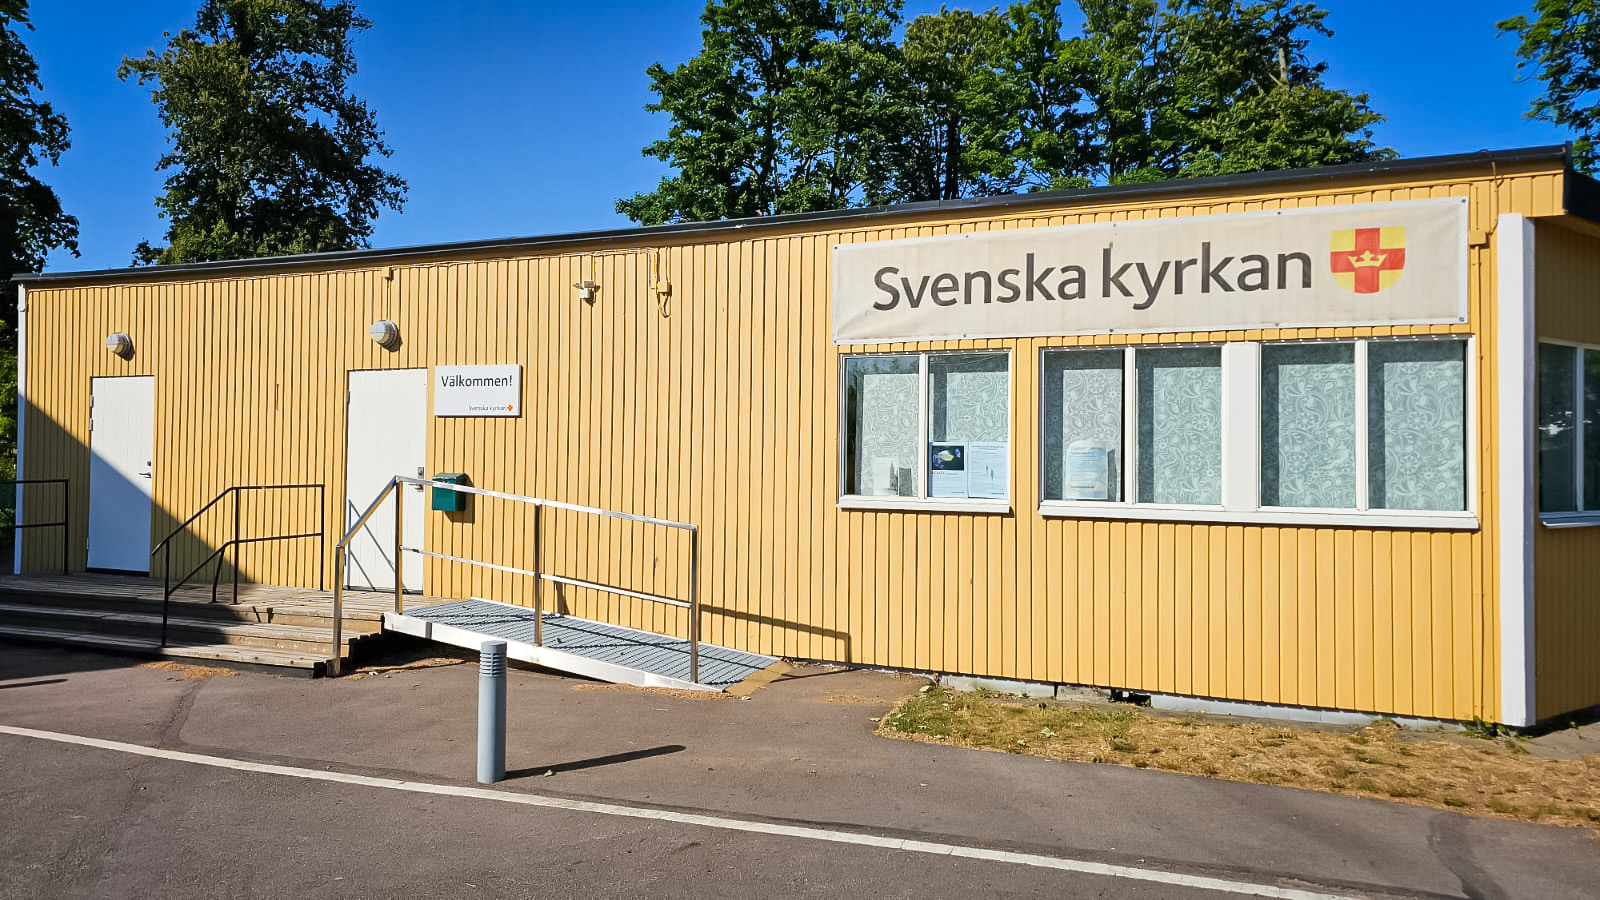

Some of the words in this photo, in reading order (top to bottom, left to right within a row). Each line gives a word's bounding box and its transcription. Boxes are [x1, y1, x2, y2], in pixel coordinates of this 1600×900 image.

[872, 252, 1086, 311] Svenska
[1102, 241, 1312, 311] kyrkan
[441, 374, 513, 388] Välkommen!
